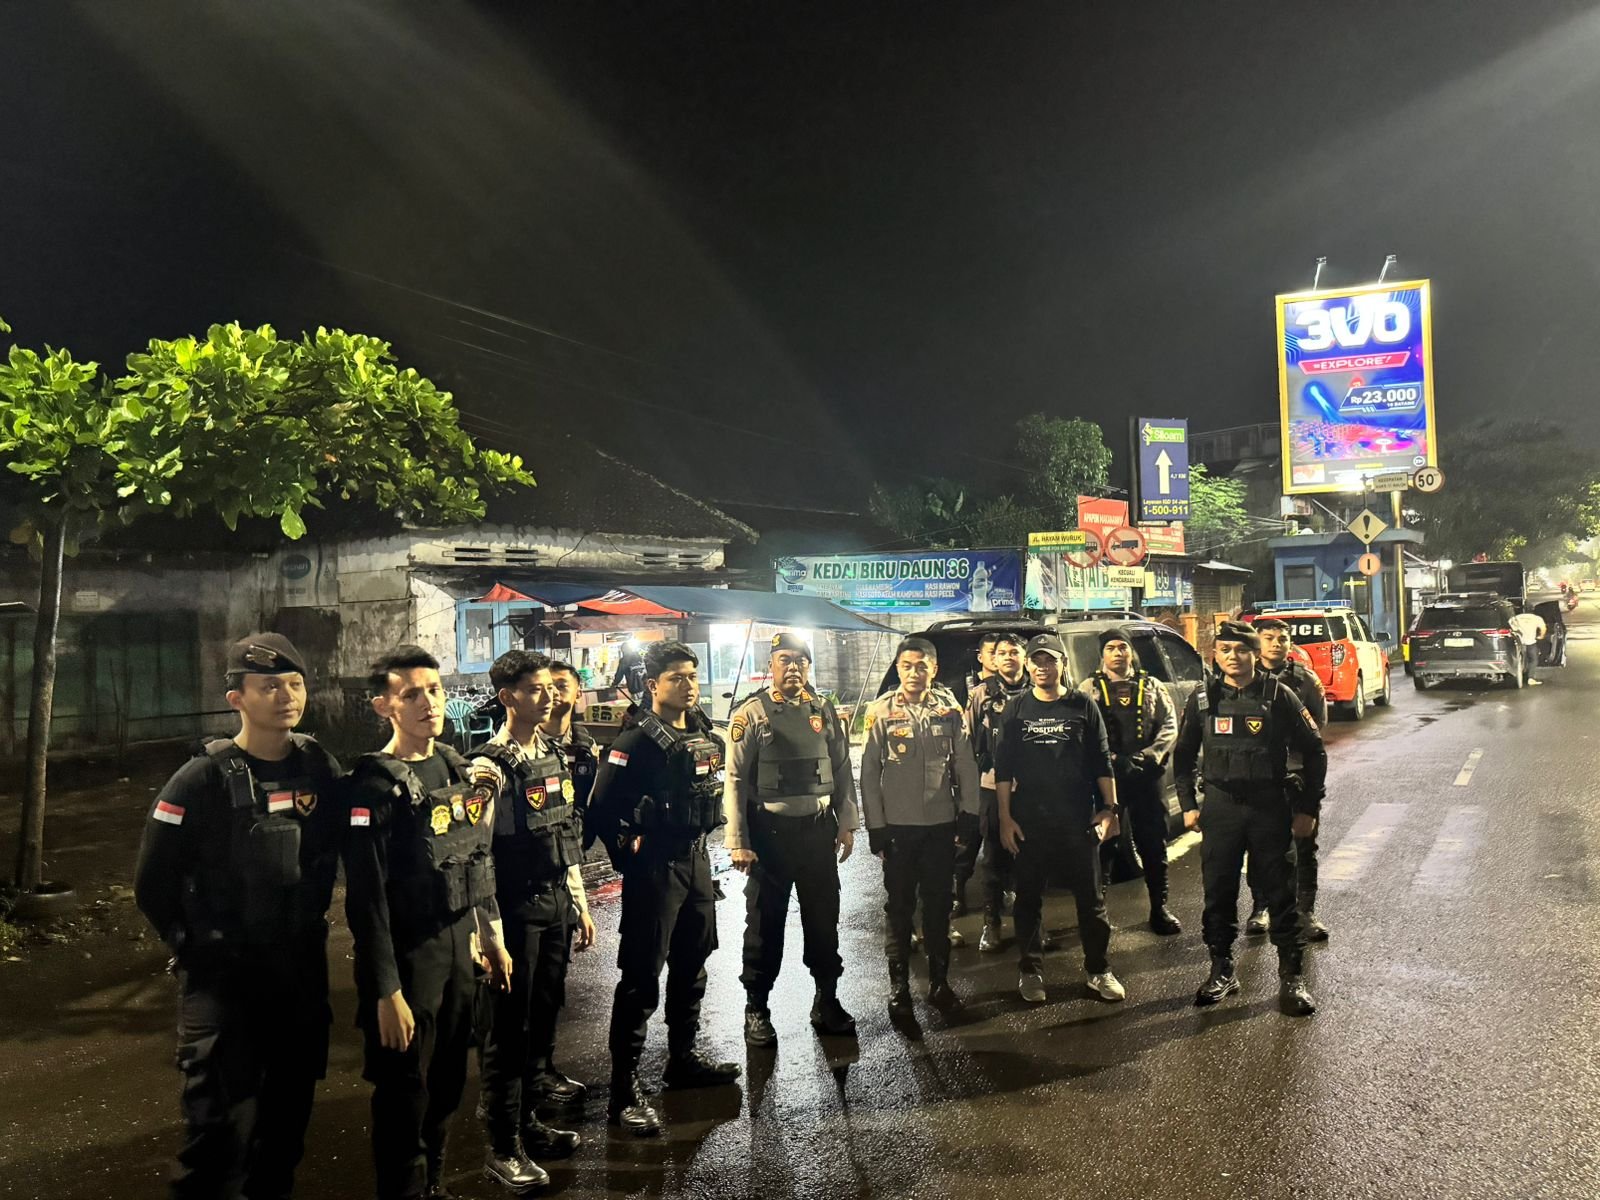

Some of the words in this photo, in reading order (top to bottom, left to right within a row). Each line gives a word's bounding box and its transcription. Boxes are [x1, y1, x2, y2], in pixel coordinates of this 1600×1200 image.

[1154, 429, 1183, 441] Siloam
[1418, 473, 1434, 488] 50
[1143, 505, 1188, 515] 1-500-911
[1061, 534, 1082, 543] WURUK
[813, 562, 857, 580] KEDAI
[859, 560, 898, 580] BIRU
[899, 559, 945, 580] DAUN
[946, 558, 970, 579] 36
[992, 598, 1016, 608] prima
[1027, 724, 1064, 735] POSITIVE
